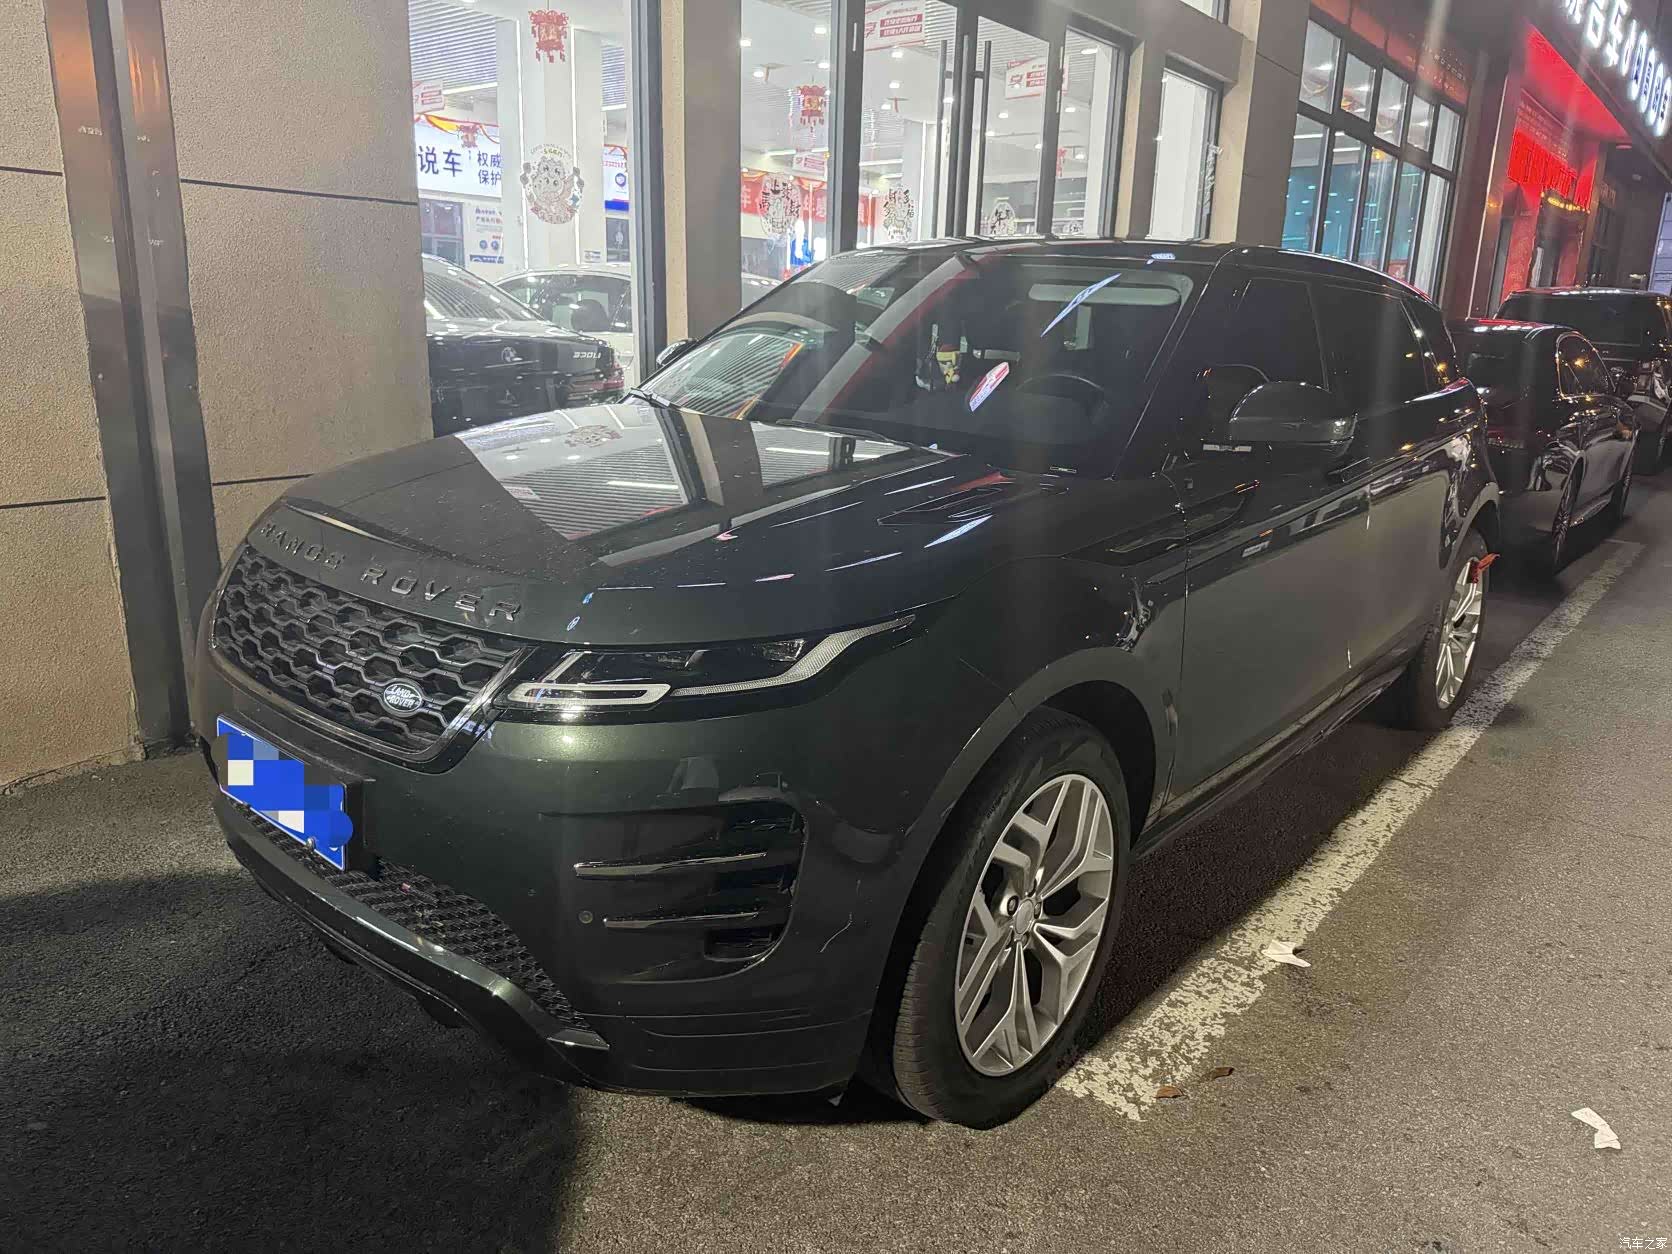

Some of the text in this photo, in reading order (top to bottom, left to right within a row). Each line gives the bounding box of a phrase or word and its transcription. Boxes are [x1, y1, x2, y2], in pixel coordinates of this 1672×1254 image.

[258, 521, 522, 622] RANGE ROVER
[389, 685, 411, 698] LAND
[388, 695, 415, 708] ROVER
